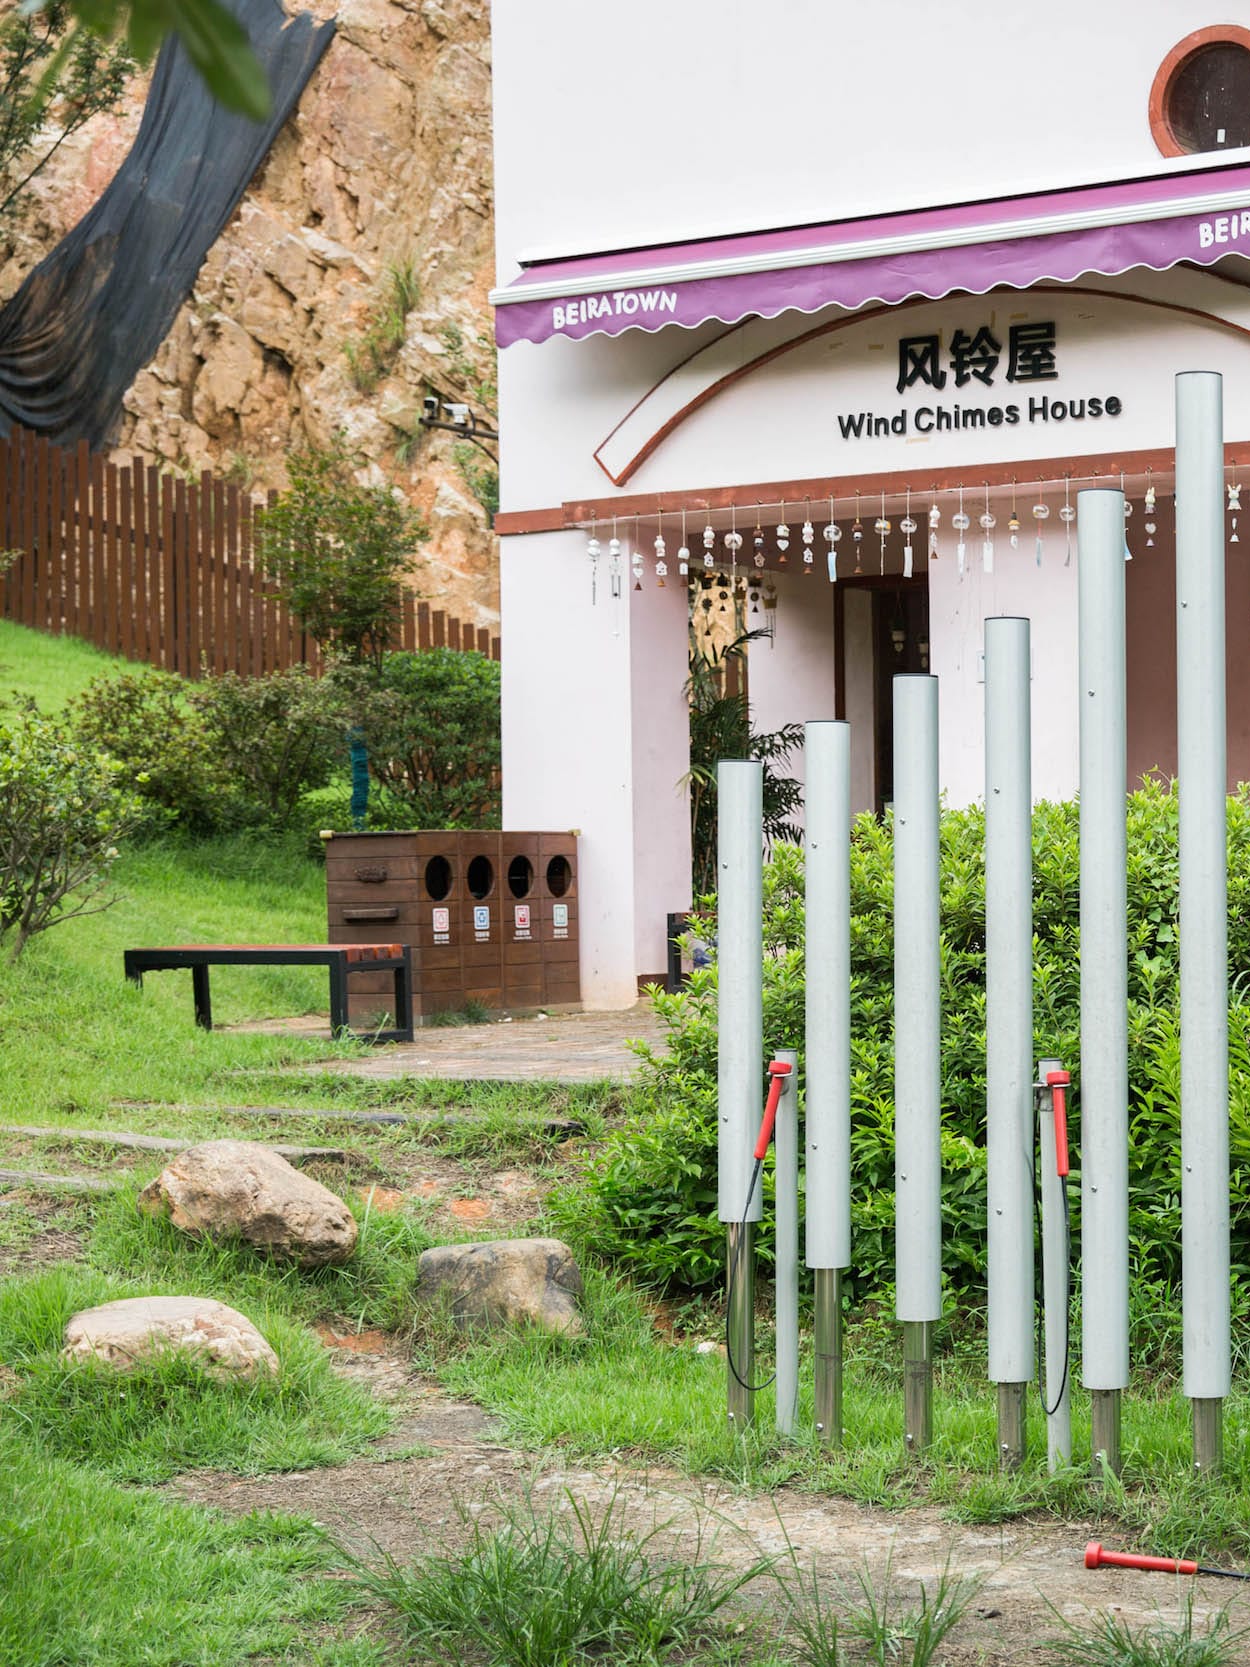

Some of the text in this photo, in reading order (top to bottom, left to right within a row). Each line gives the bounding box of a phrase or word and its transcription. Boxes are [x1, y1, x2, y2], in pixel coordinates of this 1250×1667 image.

[552, 290, 678, 330] BEIRA TOWN
[896, 321, 1058, 394] 风铃屋
[838, 396, 1123, 440] Wind Chimes House
